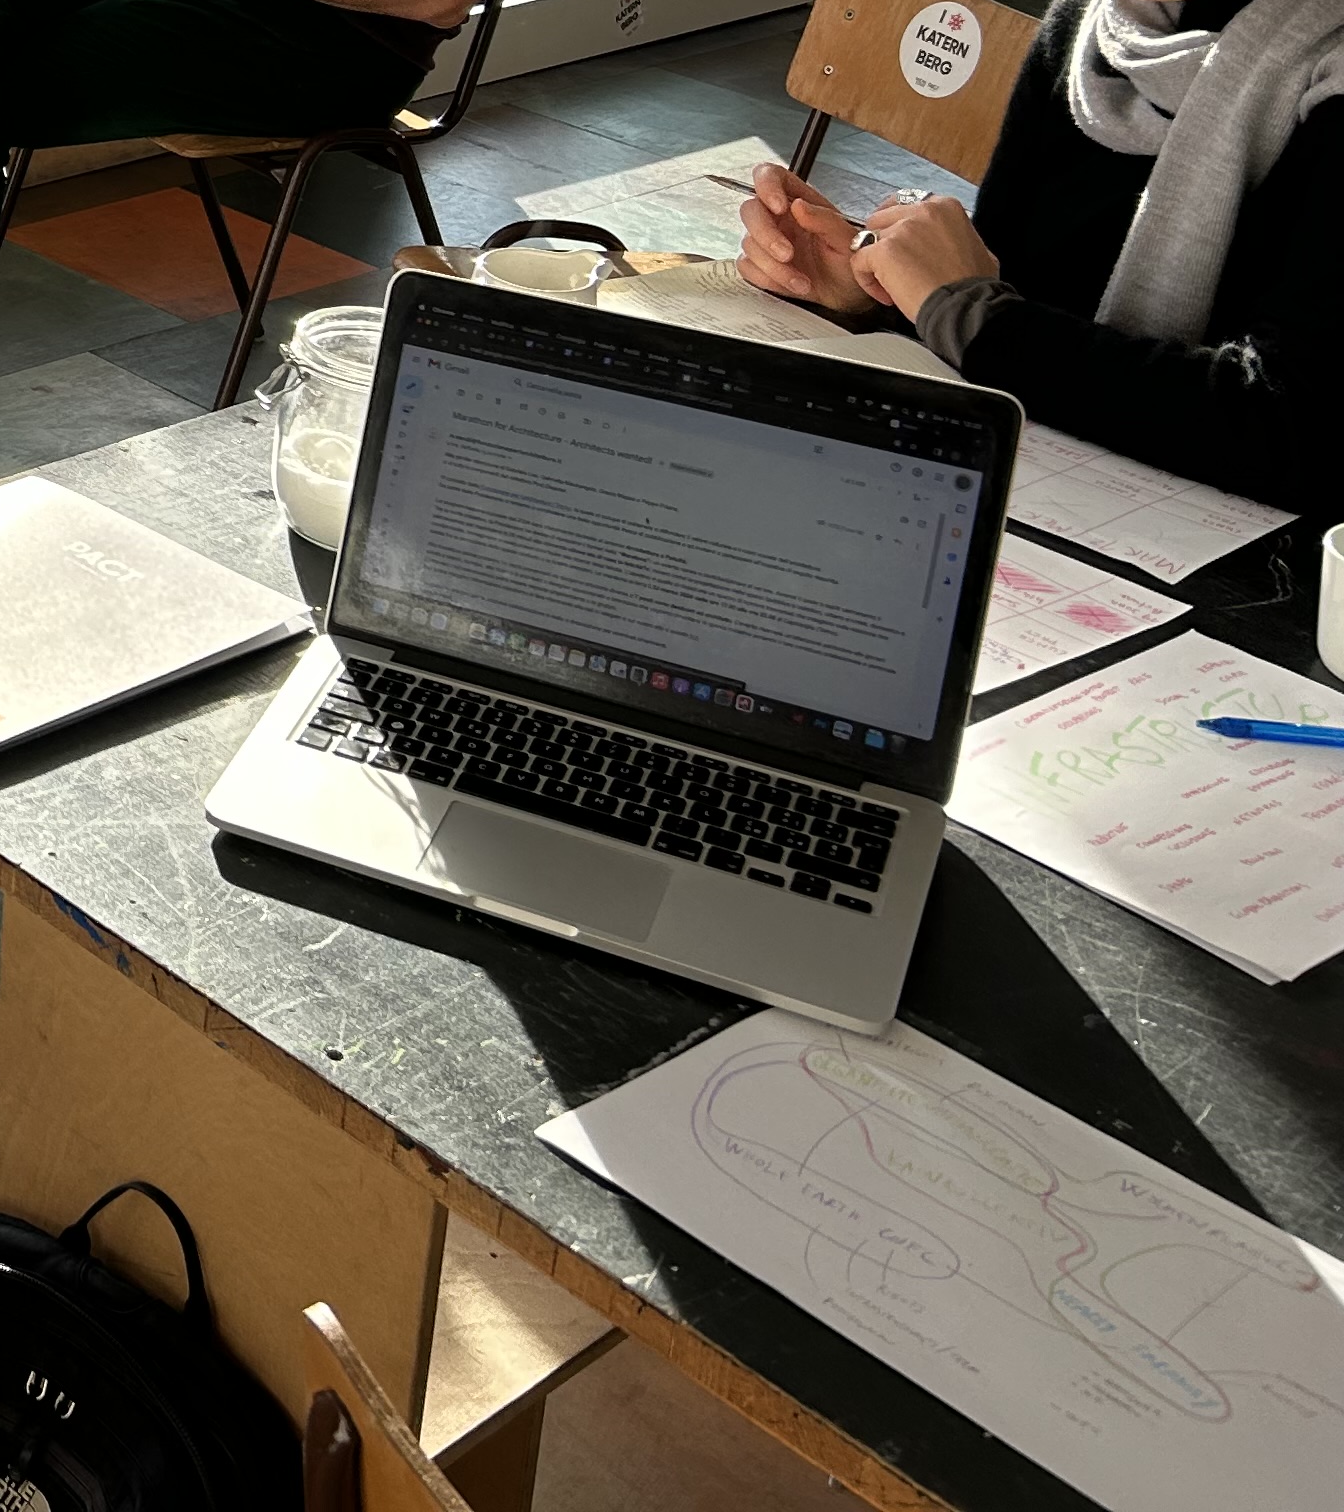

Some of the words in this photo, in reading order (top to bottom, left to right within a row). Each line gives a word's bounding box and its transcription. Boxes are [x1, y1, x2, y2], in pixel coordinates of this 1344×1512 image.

[939, 8, 948, 24] I
[915, 24, 971, 59] KATERN
[914, 49, 953, 76] BERG
[444, 362, 471, 375] Gmail
[452, 411, 494, 429] Marathon
[508, 424, 562, 444] Architecture
[570, 438, 616, 457] Architects
[61, 539, 146, 584] PACT
